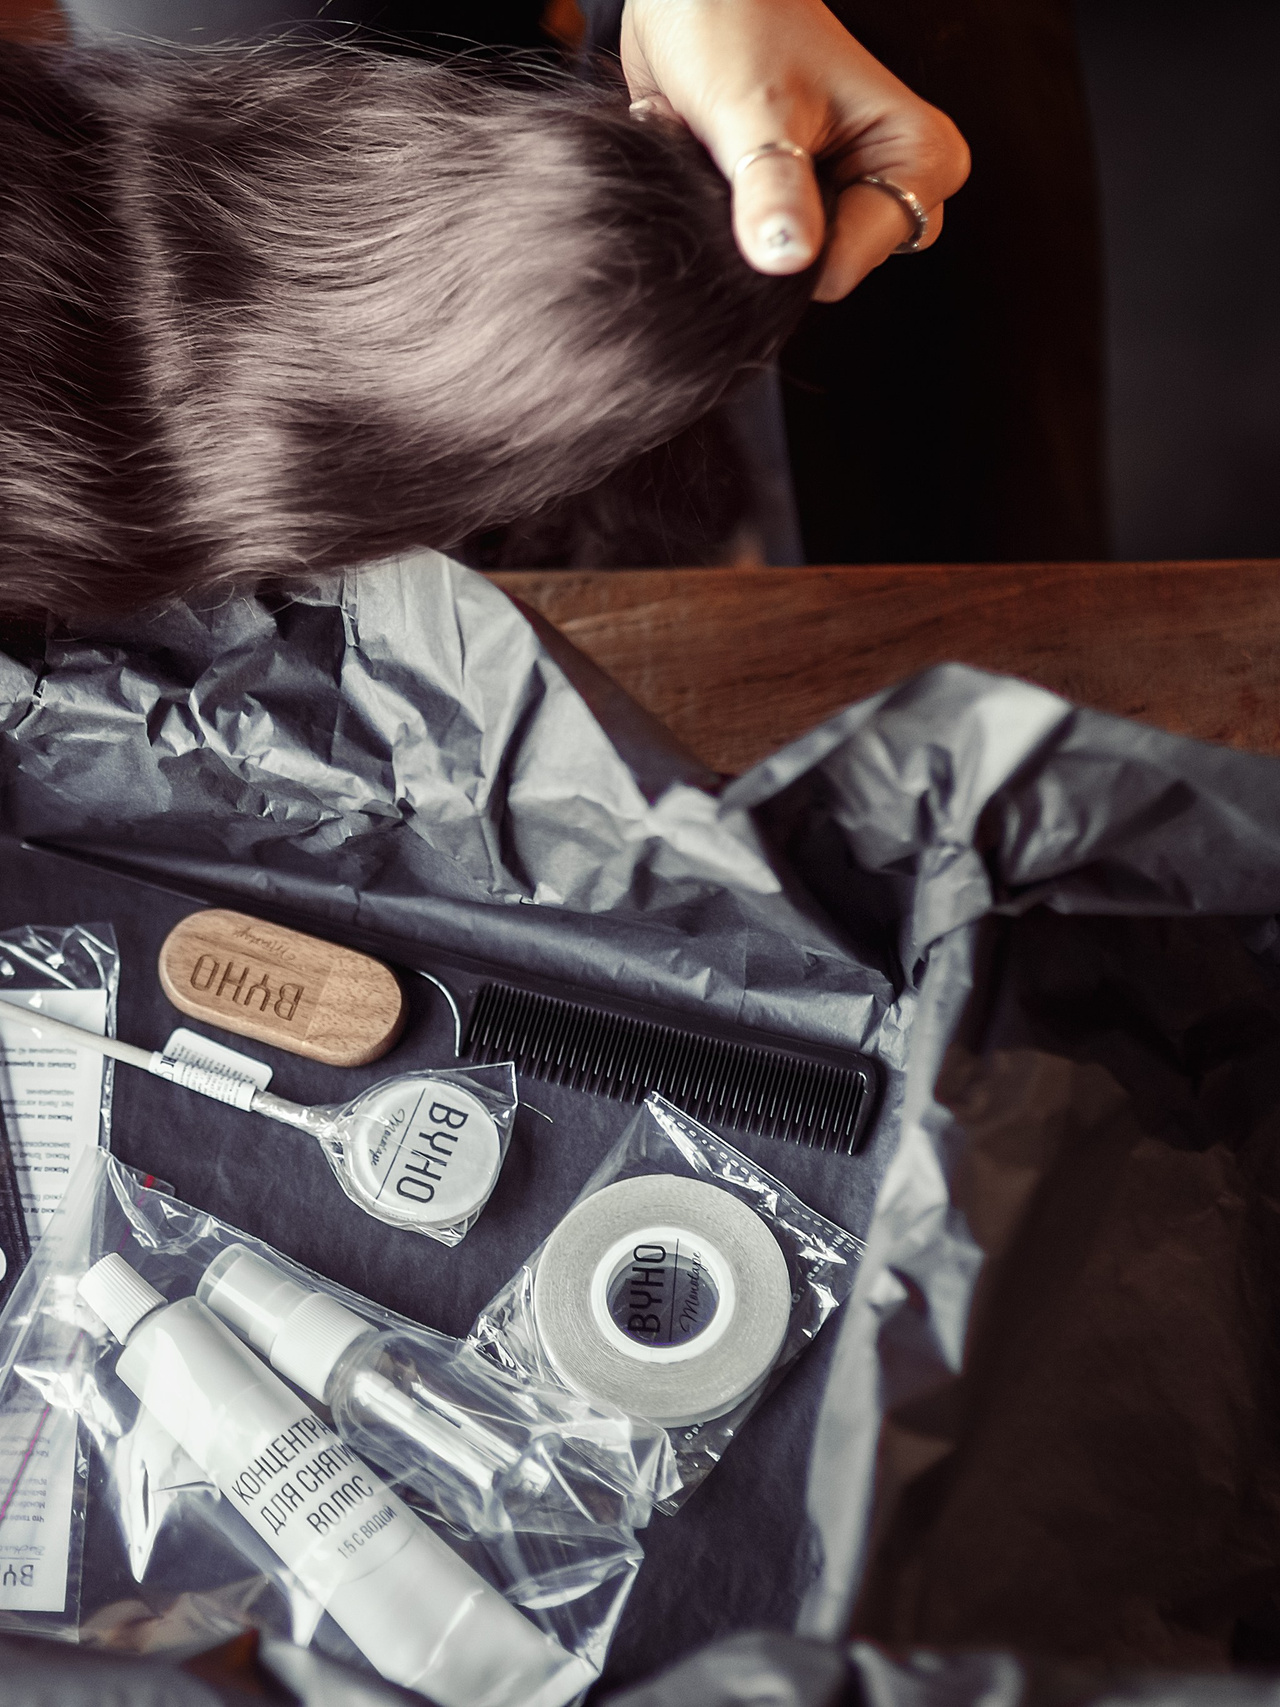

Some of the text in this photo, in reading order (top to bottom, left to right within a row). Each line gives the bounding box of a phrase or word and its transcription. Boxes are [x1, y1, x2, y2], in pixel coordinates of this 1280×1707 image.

[190, 953, 305, 1022] BYHO
[396, 1102, 470, 1204] BYHO
[626, 1243, 668, 1336] BYHO
[681, 1250, 704, 1332] Monotape
[260, 1482, 303, 1536] ДЛЯ
[306, 1475, 374, 1537] ВОЛОС
[358, 1503, 398, 1539] ВОДОЙ
